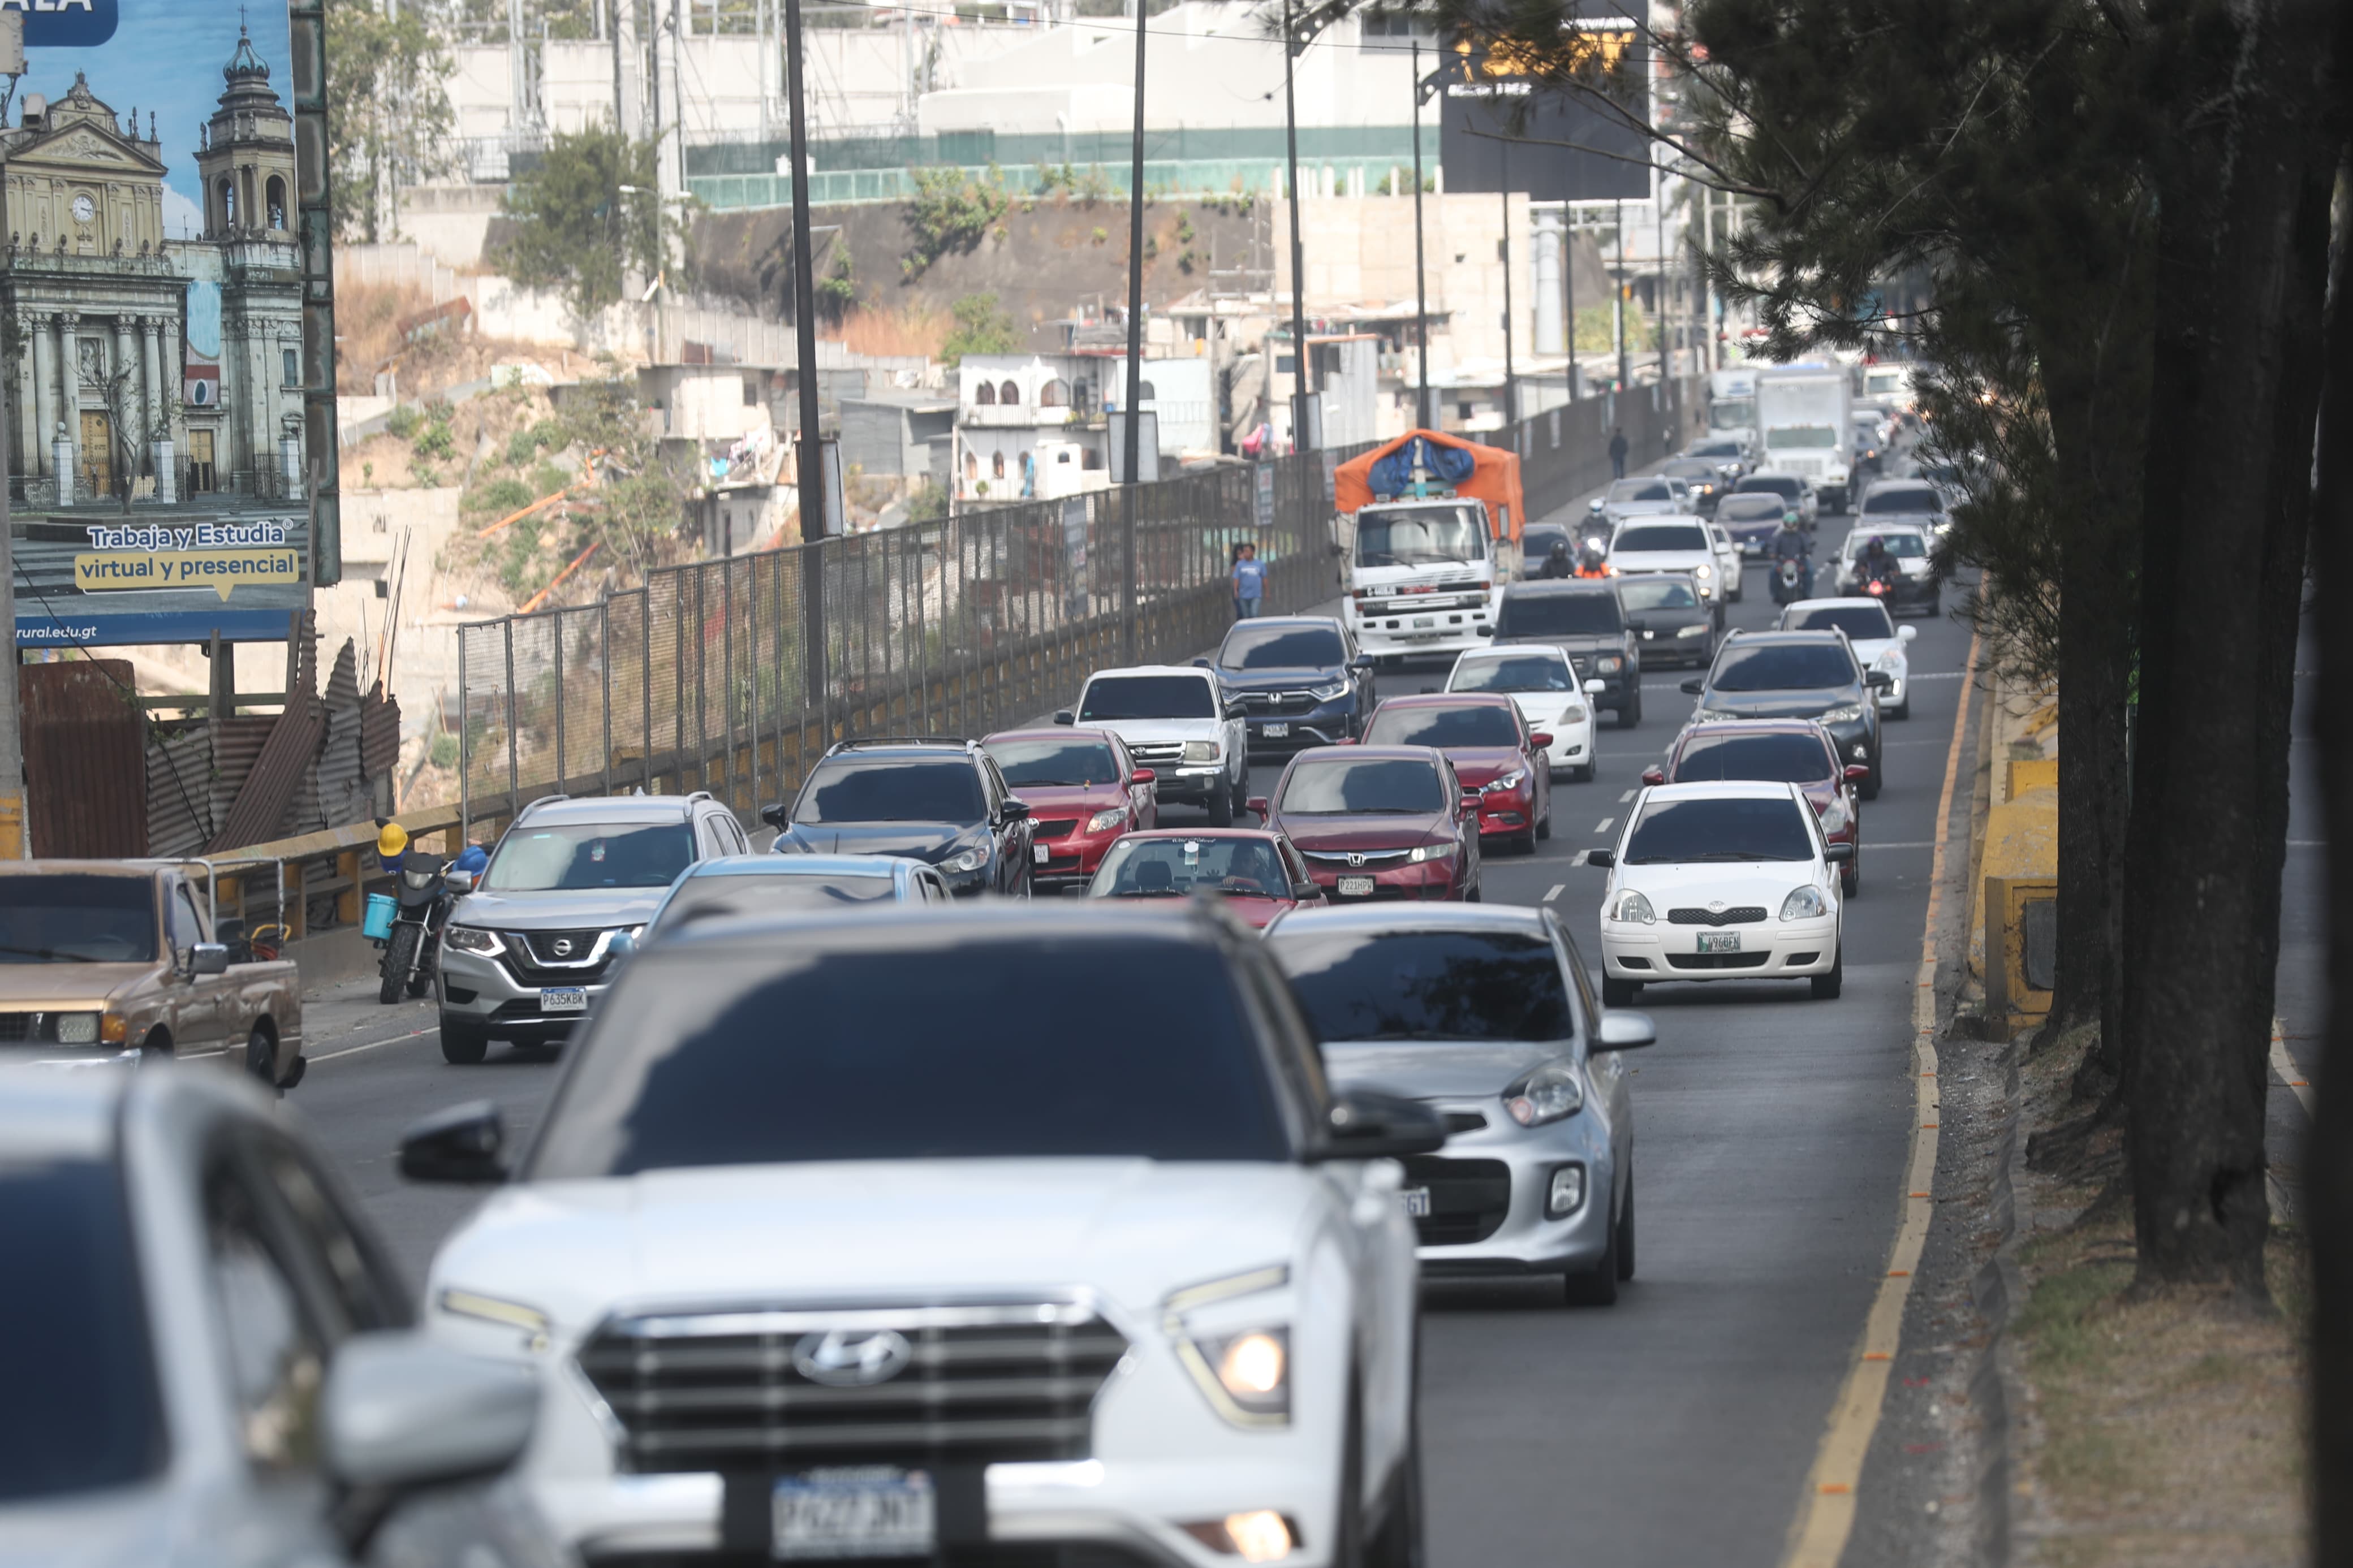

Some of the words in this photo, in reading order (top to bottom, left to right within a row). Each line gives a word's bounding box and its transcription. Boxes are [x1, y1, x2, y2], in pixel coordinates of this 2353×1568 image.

[89, 526, 170, 550] Trabaja
[176, 529, 191, 548] y
[80, 558, 153, 578] virtual
[160, 562, 174, 581] y
[181, 554, 294, 580] presencial
[16, 626, 97, 640] rural.edu.gt
[543, 993, 584, 1006] P635KBK
